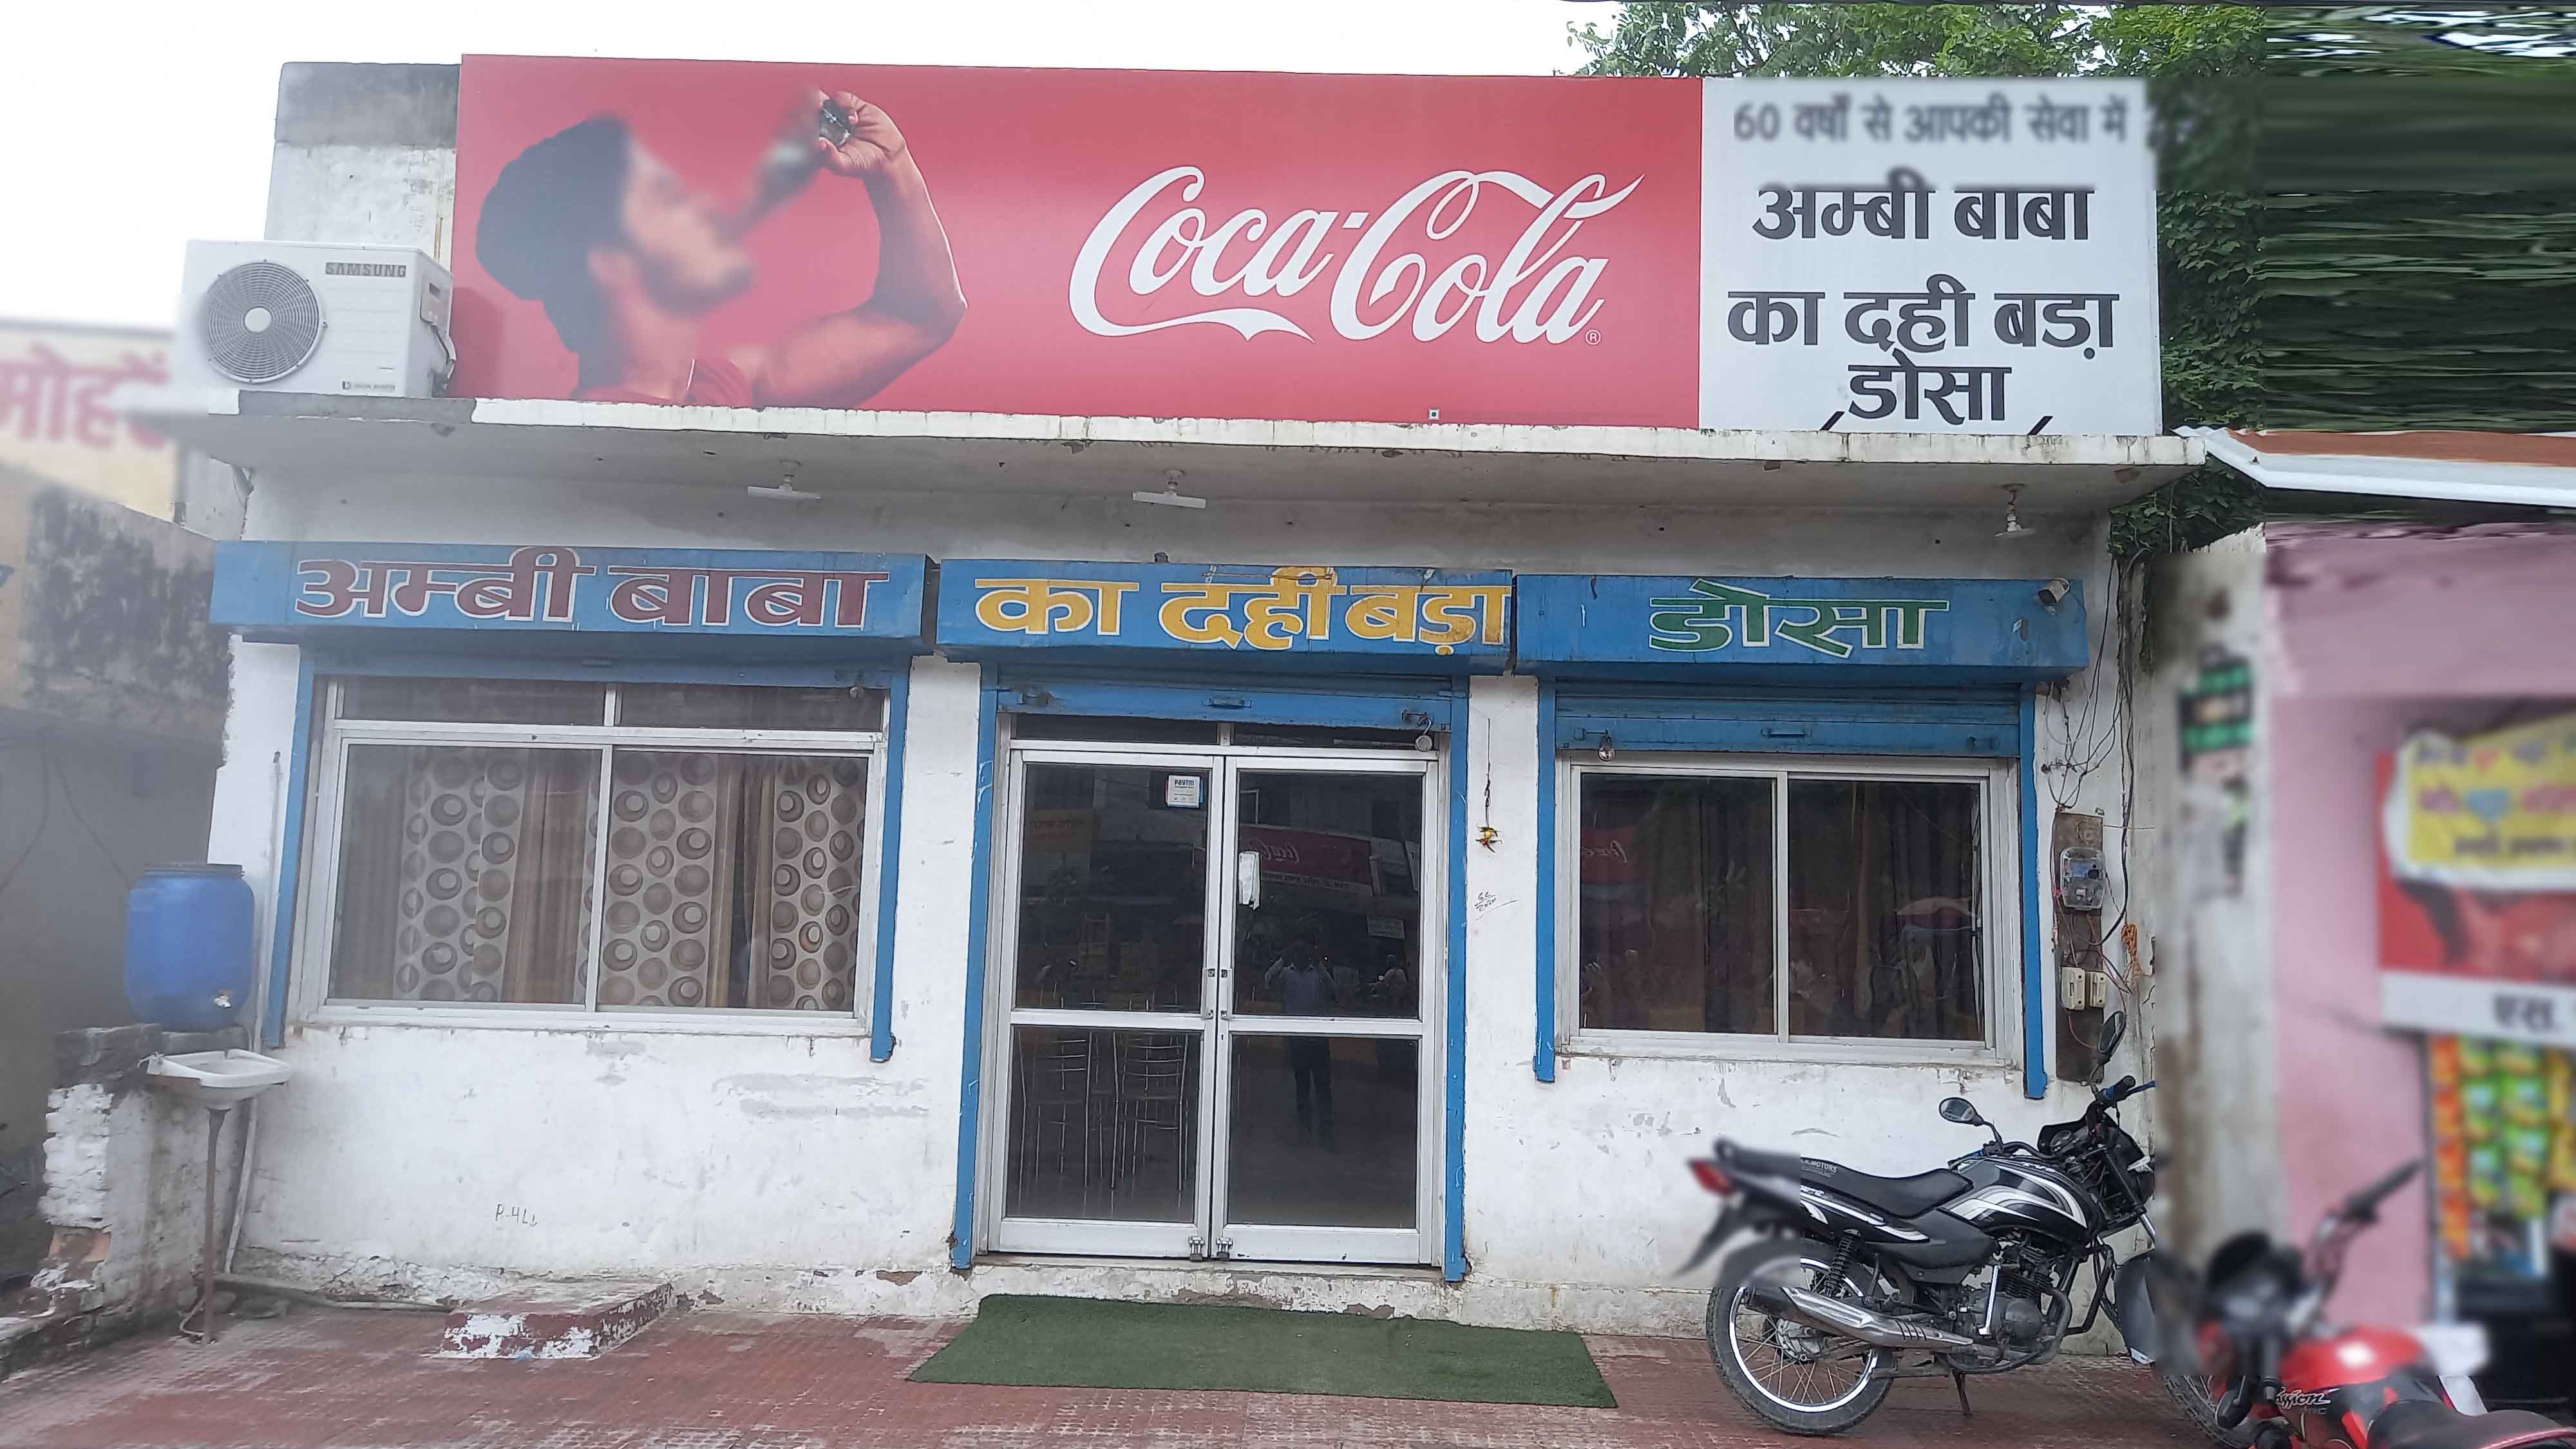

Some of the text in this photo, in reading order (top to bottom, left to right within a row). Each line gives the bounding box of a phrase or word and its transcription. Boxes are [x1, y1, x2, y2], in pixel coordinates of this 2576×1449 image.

[1734, 103, 1781, 142] 60
[1862, 94, 1892, 141] से
[1904, 93, 2012, 142] आपकी
[2024, 95, 2089, 141] सेवा
[2100, 94, 2129, 141] में
[1752, 166, 2095, 240] अम्बी बाबा
[325, 262, 406, 277] SAMSUNG
[1068, 166, 1645, 346] Coca-Cola
[1727, 274, 2120, 359] का दही बड़ा
[1848, 348, 2011, 425] डोसा
[295, 547, 1949, 659] अम्बी बाबा का दही बड़ा डोसा
